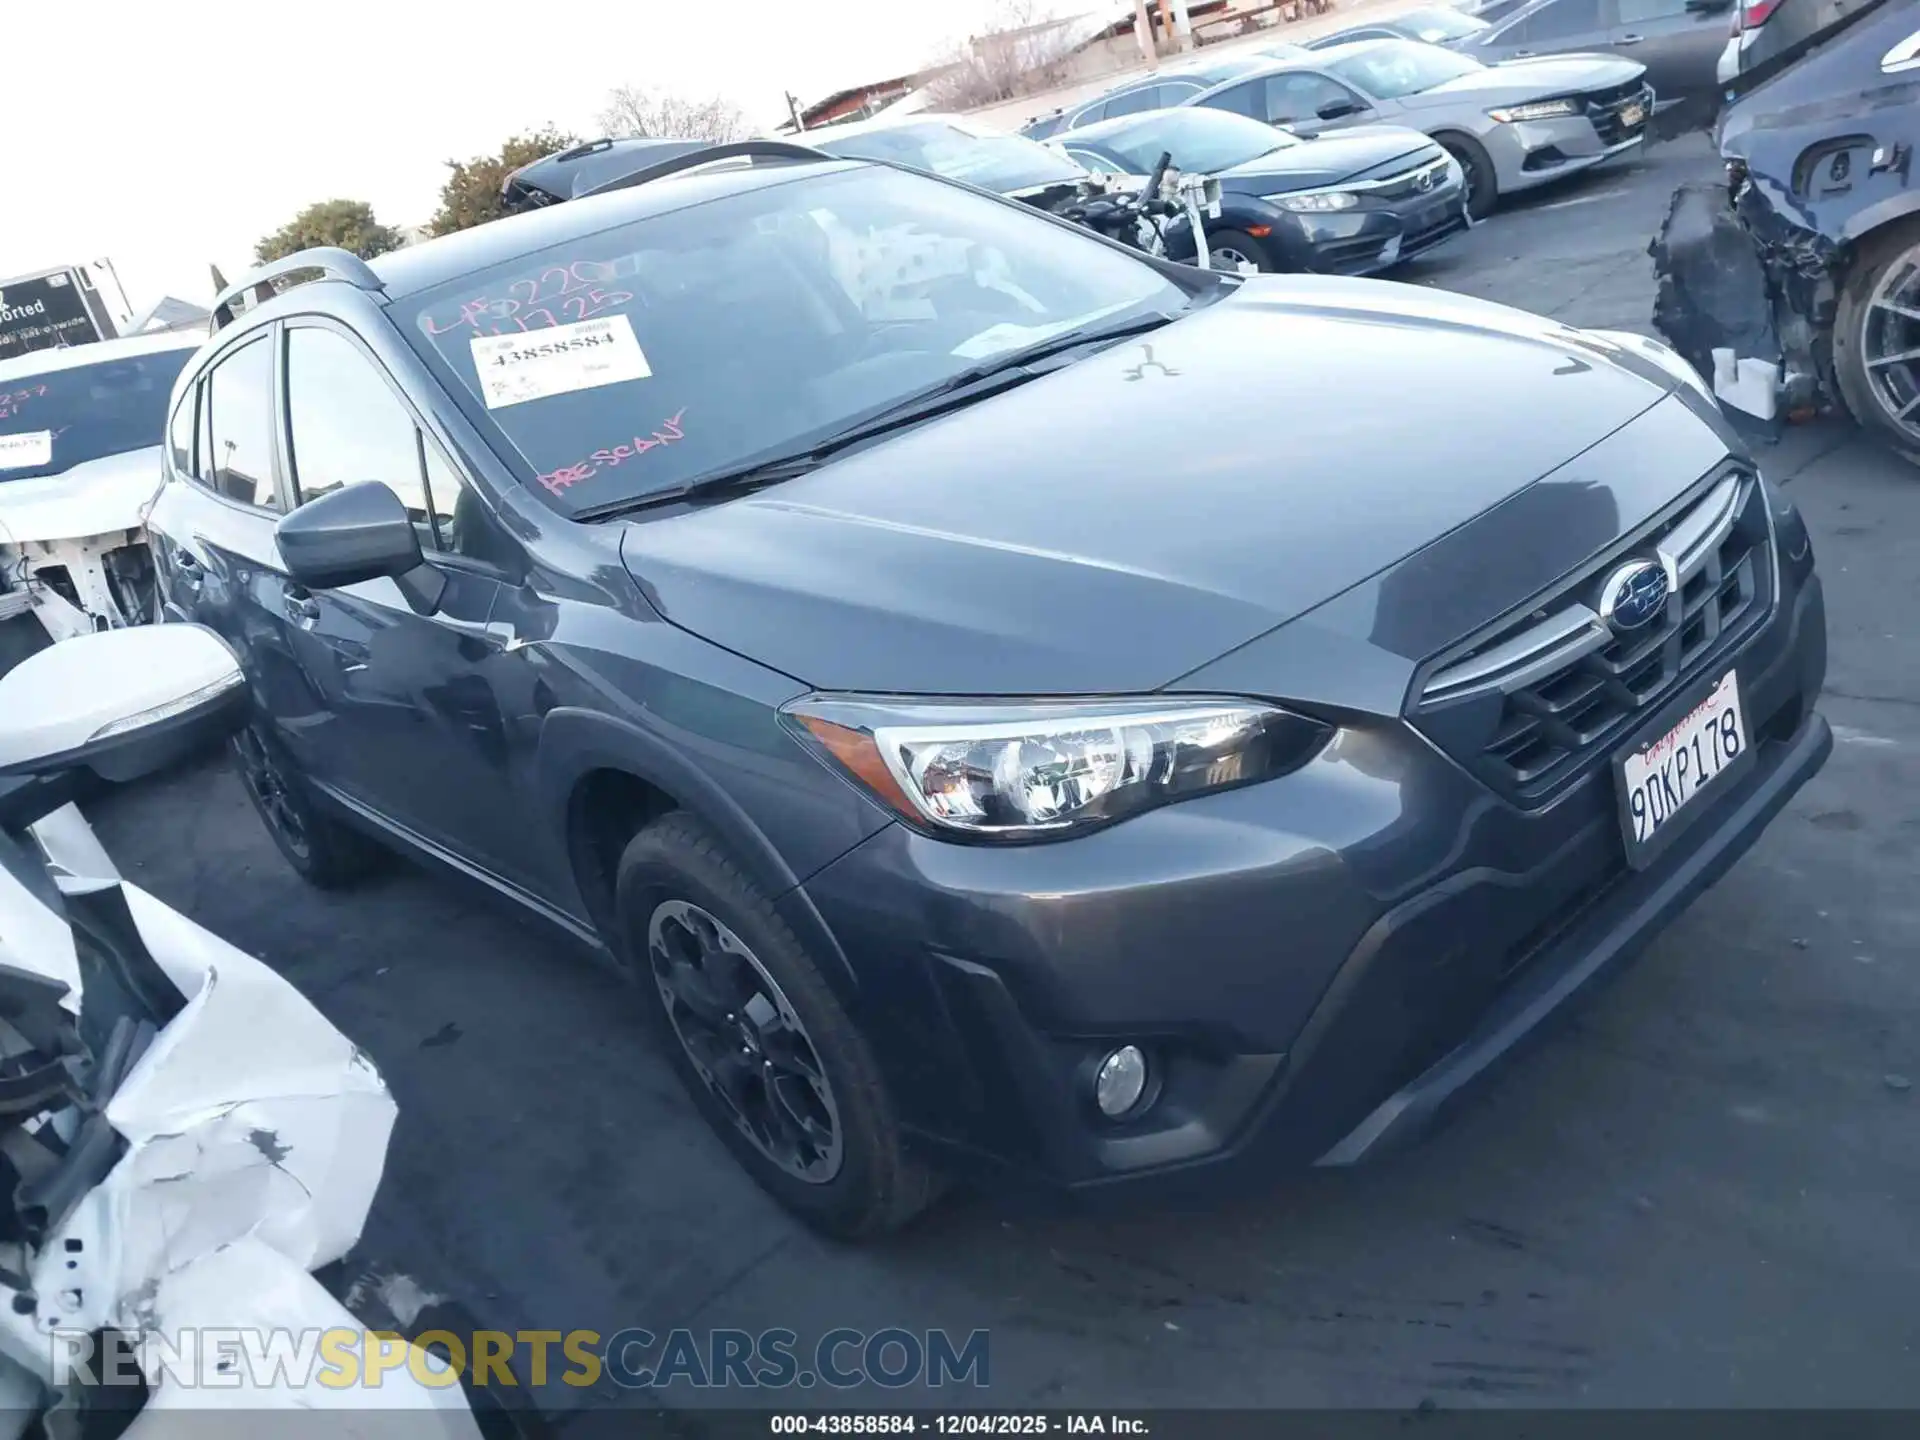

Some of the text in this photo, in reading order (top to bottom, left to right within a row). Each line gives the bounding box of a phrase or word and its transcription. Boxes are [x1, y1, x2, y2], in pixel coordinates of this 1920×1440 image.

[0, 298, 45, 323] orted
[491, 332, 616, 367] 43858584
[1631, 707, 1740, 843] 9DKP178
